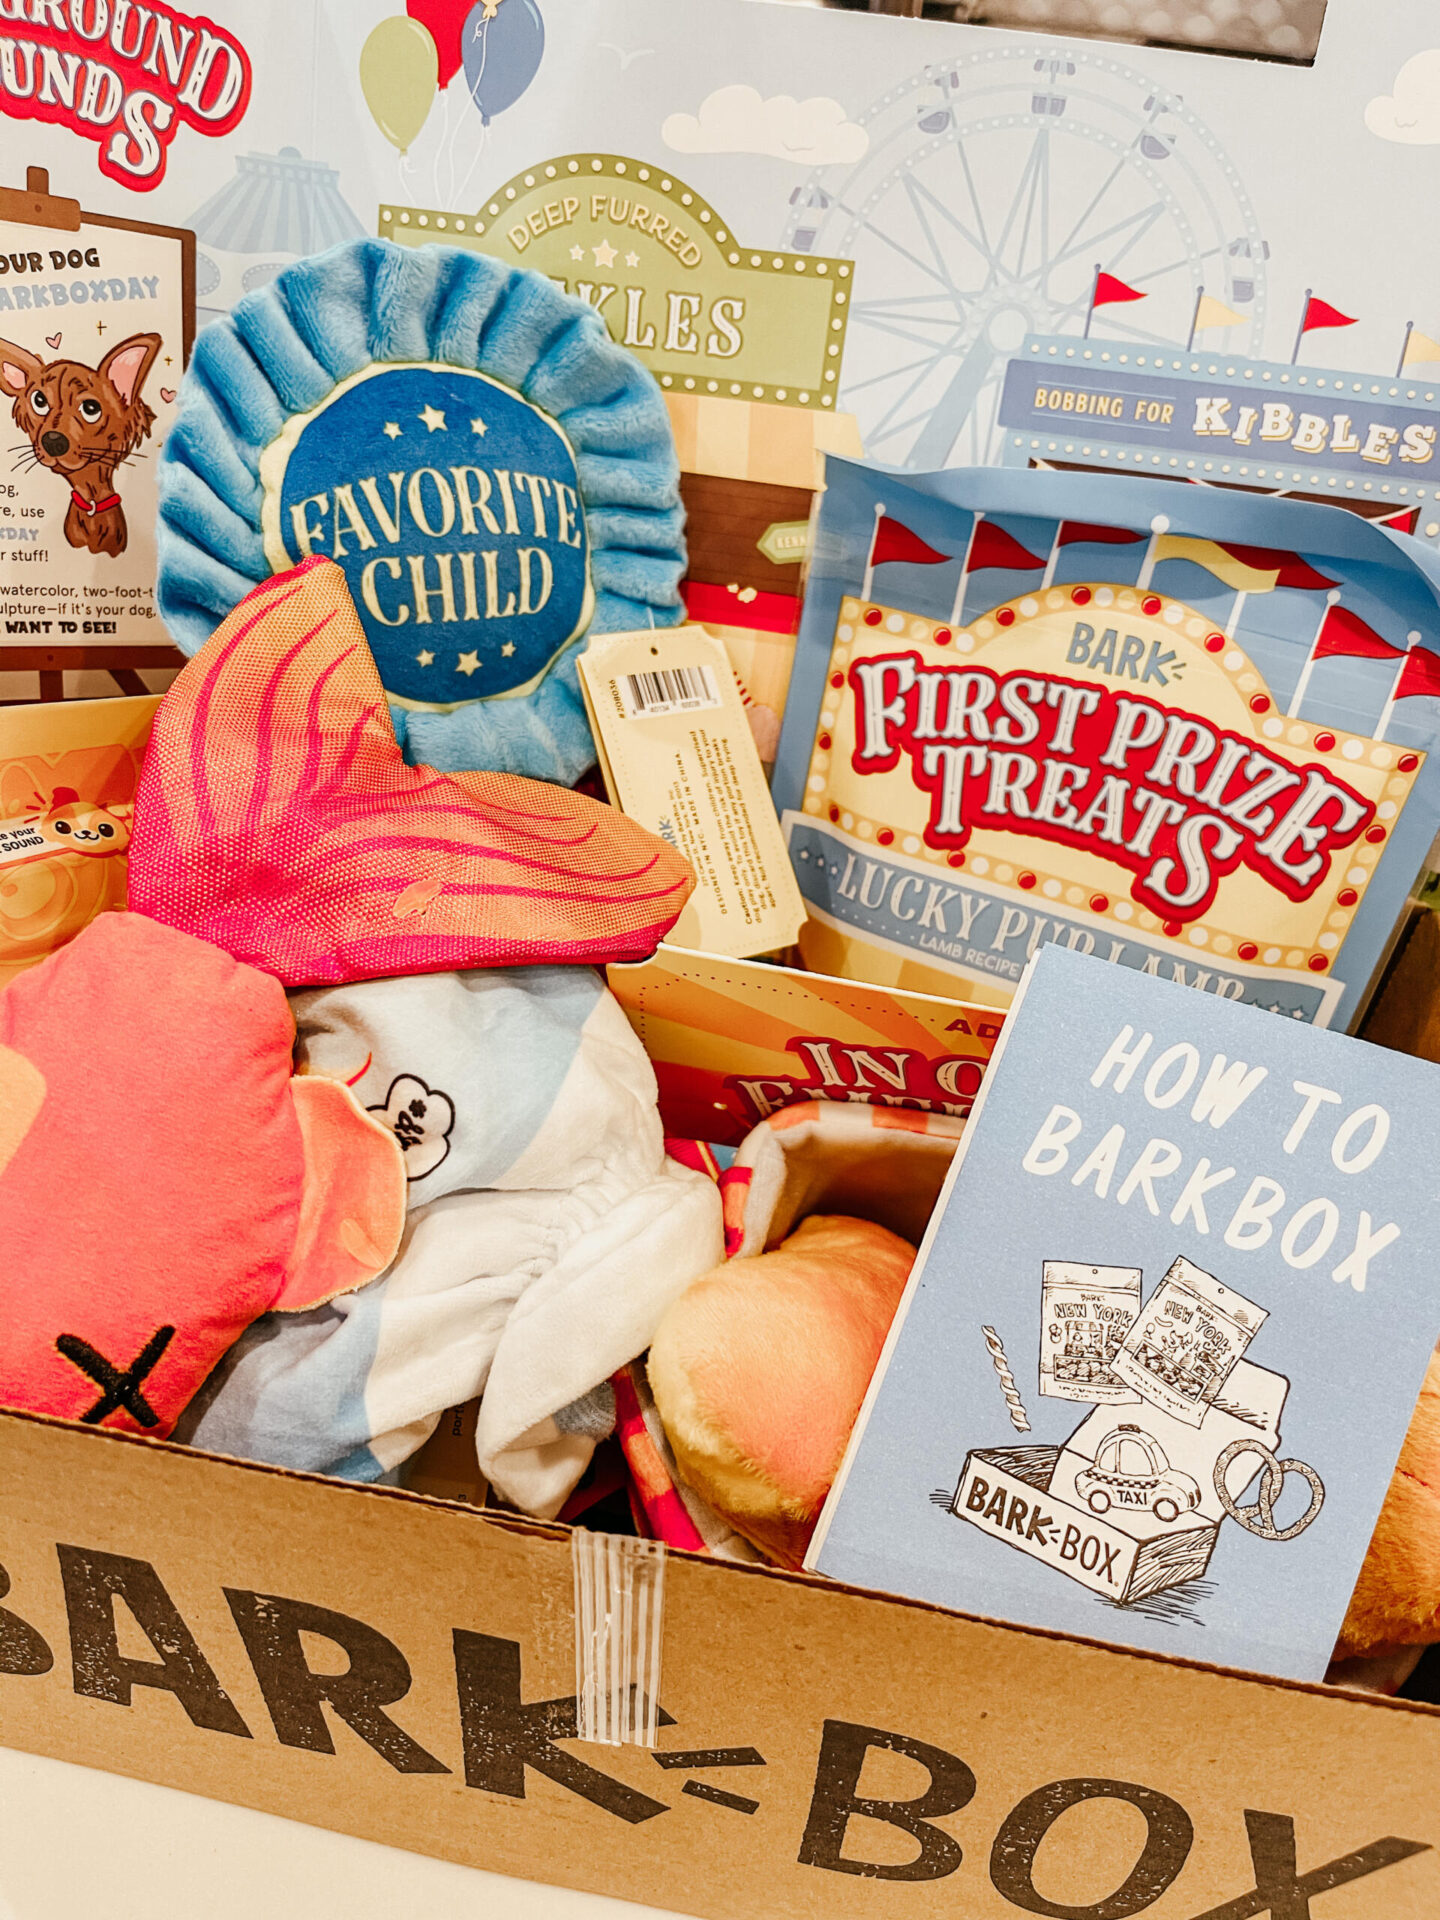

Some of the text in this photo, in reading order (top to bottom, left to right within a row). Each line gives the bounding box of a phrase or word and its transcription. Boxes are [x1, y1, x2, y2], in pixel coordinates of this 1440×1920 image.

[508, 195, 702, 268] DEEP FURRED
[49, 248, 100, 270] DOG
[0, 275, 159, 311] ARKBOXDAY
[1034, 388, 1437, 465] BOBBING FOR KIBBLES
[21, 507, 45, 518] use
[12, 549, 49, 562] stuff!
[289, 466, 581, 627] FAVORITE CHILD
[0, 584, 79, 598] watercolor,
[72, 603, 92, 615] it's
[96, 606, 125, 618] your
[129, 604, 157, 618] dog,
[5, 621, 117, 634] WANT TO SEE!
[1065, 621, 1177, 688] BARK
[699, 729, 709, 746] your
[689, 730, 708, 776] Supervised
[710, 739, 723, 765] breaks
[708, 760, 720, 782] injury
[728, 765, 740, 785] deep
[855, 657, 1369, 888] FIRST PRIZE
[684, 786, 691, 795] IN
[719, 768, 734, 798] portion
[688, 800, 700, 823] MADE
[719, 798, 727, 811] risk
[730, 802, 739, 815] any
[715, 820, 726, 838] from
[724, 815, 732, 827] the
[737, 826, 746, 838] toy
[922, 744, 1245, 907] TREATS
[9, 827, 36, 839] your
[728, 830, 739, 851] avoid
[739, 803, 762, 862] recommended
[1, 836, 44, 852] SOUND
[723, 841, 733, 860] away
[741, 842, 750, 856] this
[704, 855, 711, 863] IN
[729, 864, 740, 885] Keep
[746, 859, 760, 888] discard
[758, 866, 767, 880] Not
[708, 868, 727, 913] DESIGNED
[746, 889, 757, 904] play
[837, 852, 991, 941] LUCKY
[736, 889, 752, 923] Caution:
[752, 908, 762, 922] dog
[919, 934, 1020, 978] LAMB RECIPE
[801, 1042, 910, 1090] IN
[1090, 1024, 1390, 1174] HOW TO
[1022, 1105, 1400, 1292] BARKBOX
[1054, 1303, 1133, 1328] NEW YORK
[1164, 1300, 1231, 1355] NEW YORK
[1117, 1490, 1147, 1505] TAXI
[966, 1476, 1121, 1584] BARK BOX
[797, 1719, 1433, 1920] BOX
